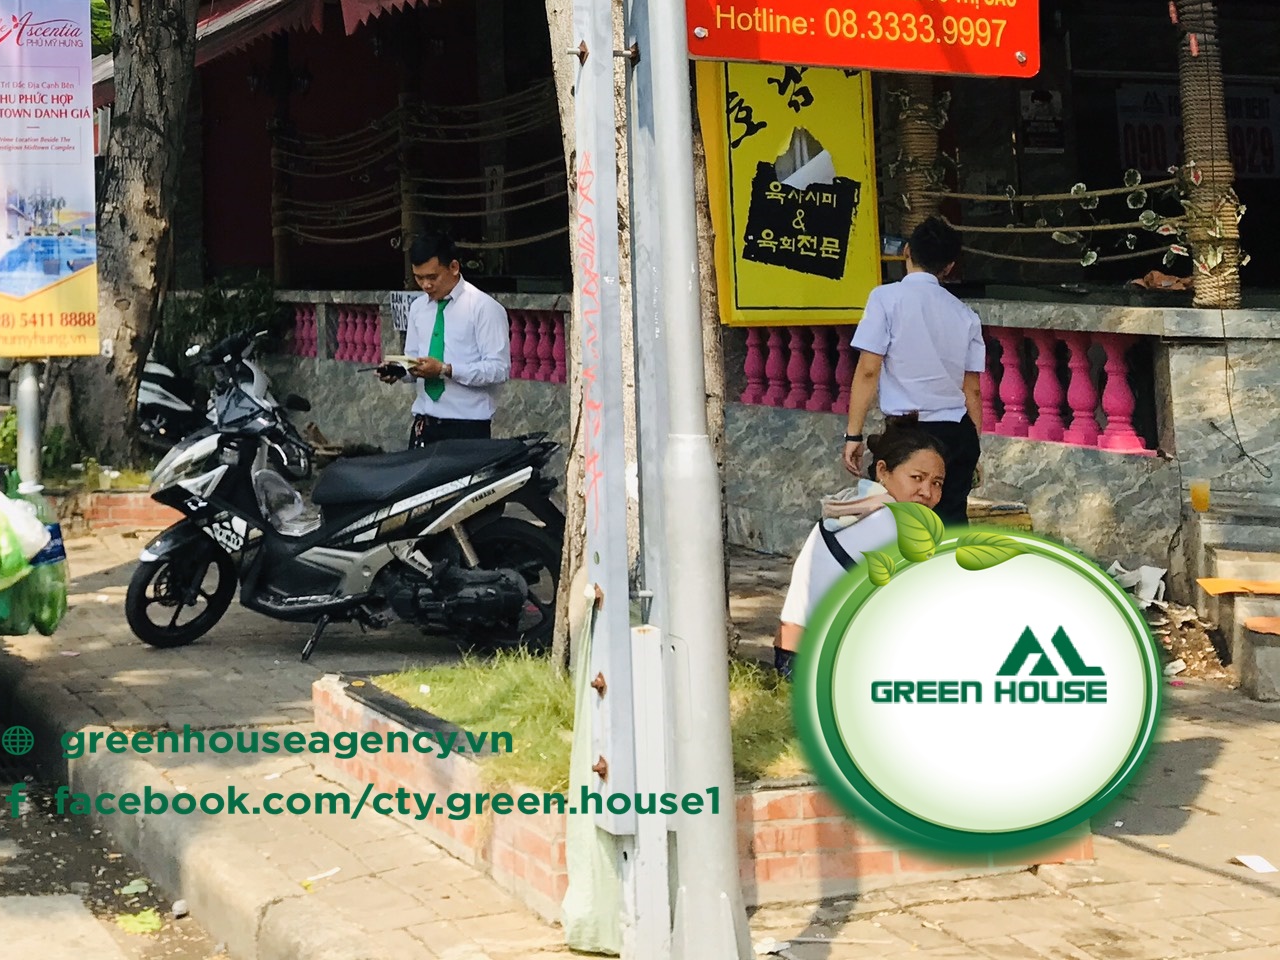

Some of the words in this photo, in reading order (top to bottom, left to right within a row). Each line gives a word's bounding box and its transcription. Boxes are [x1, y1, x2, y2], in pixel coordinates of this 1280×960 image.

[715, 5, 815, 36] Hotline:
[824, 7, 1007, 48] 08.3333.9997
[19, 91, 48, 104] PHỨC
[34, 108, 68, 119] DANH
[71, 106, 91, 119] GIÁ
[765, 181, 838, 209] 육사시미
[792, 209, 806, 233] &
[757, 228, 842, 259] 육회전문
[20, 313, 53, 327] 5411
[59, 312, 96, 327] 8888
